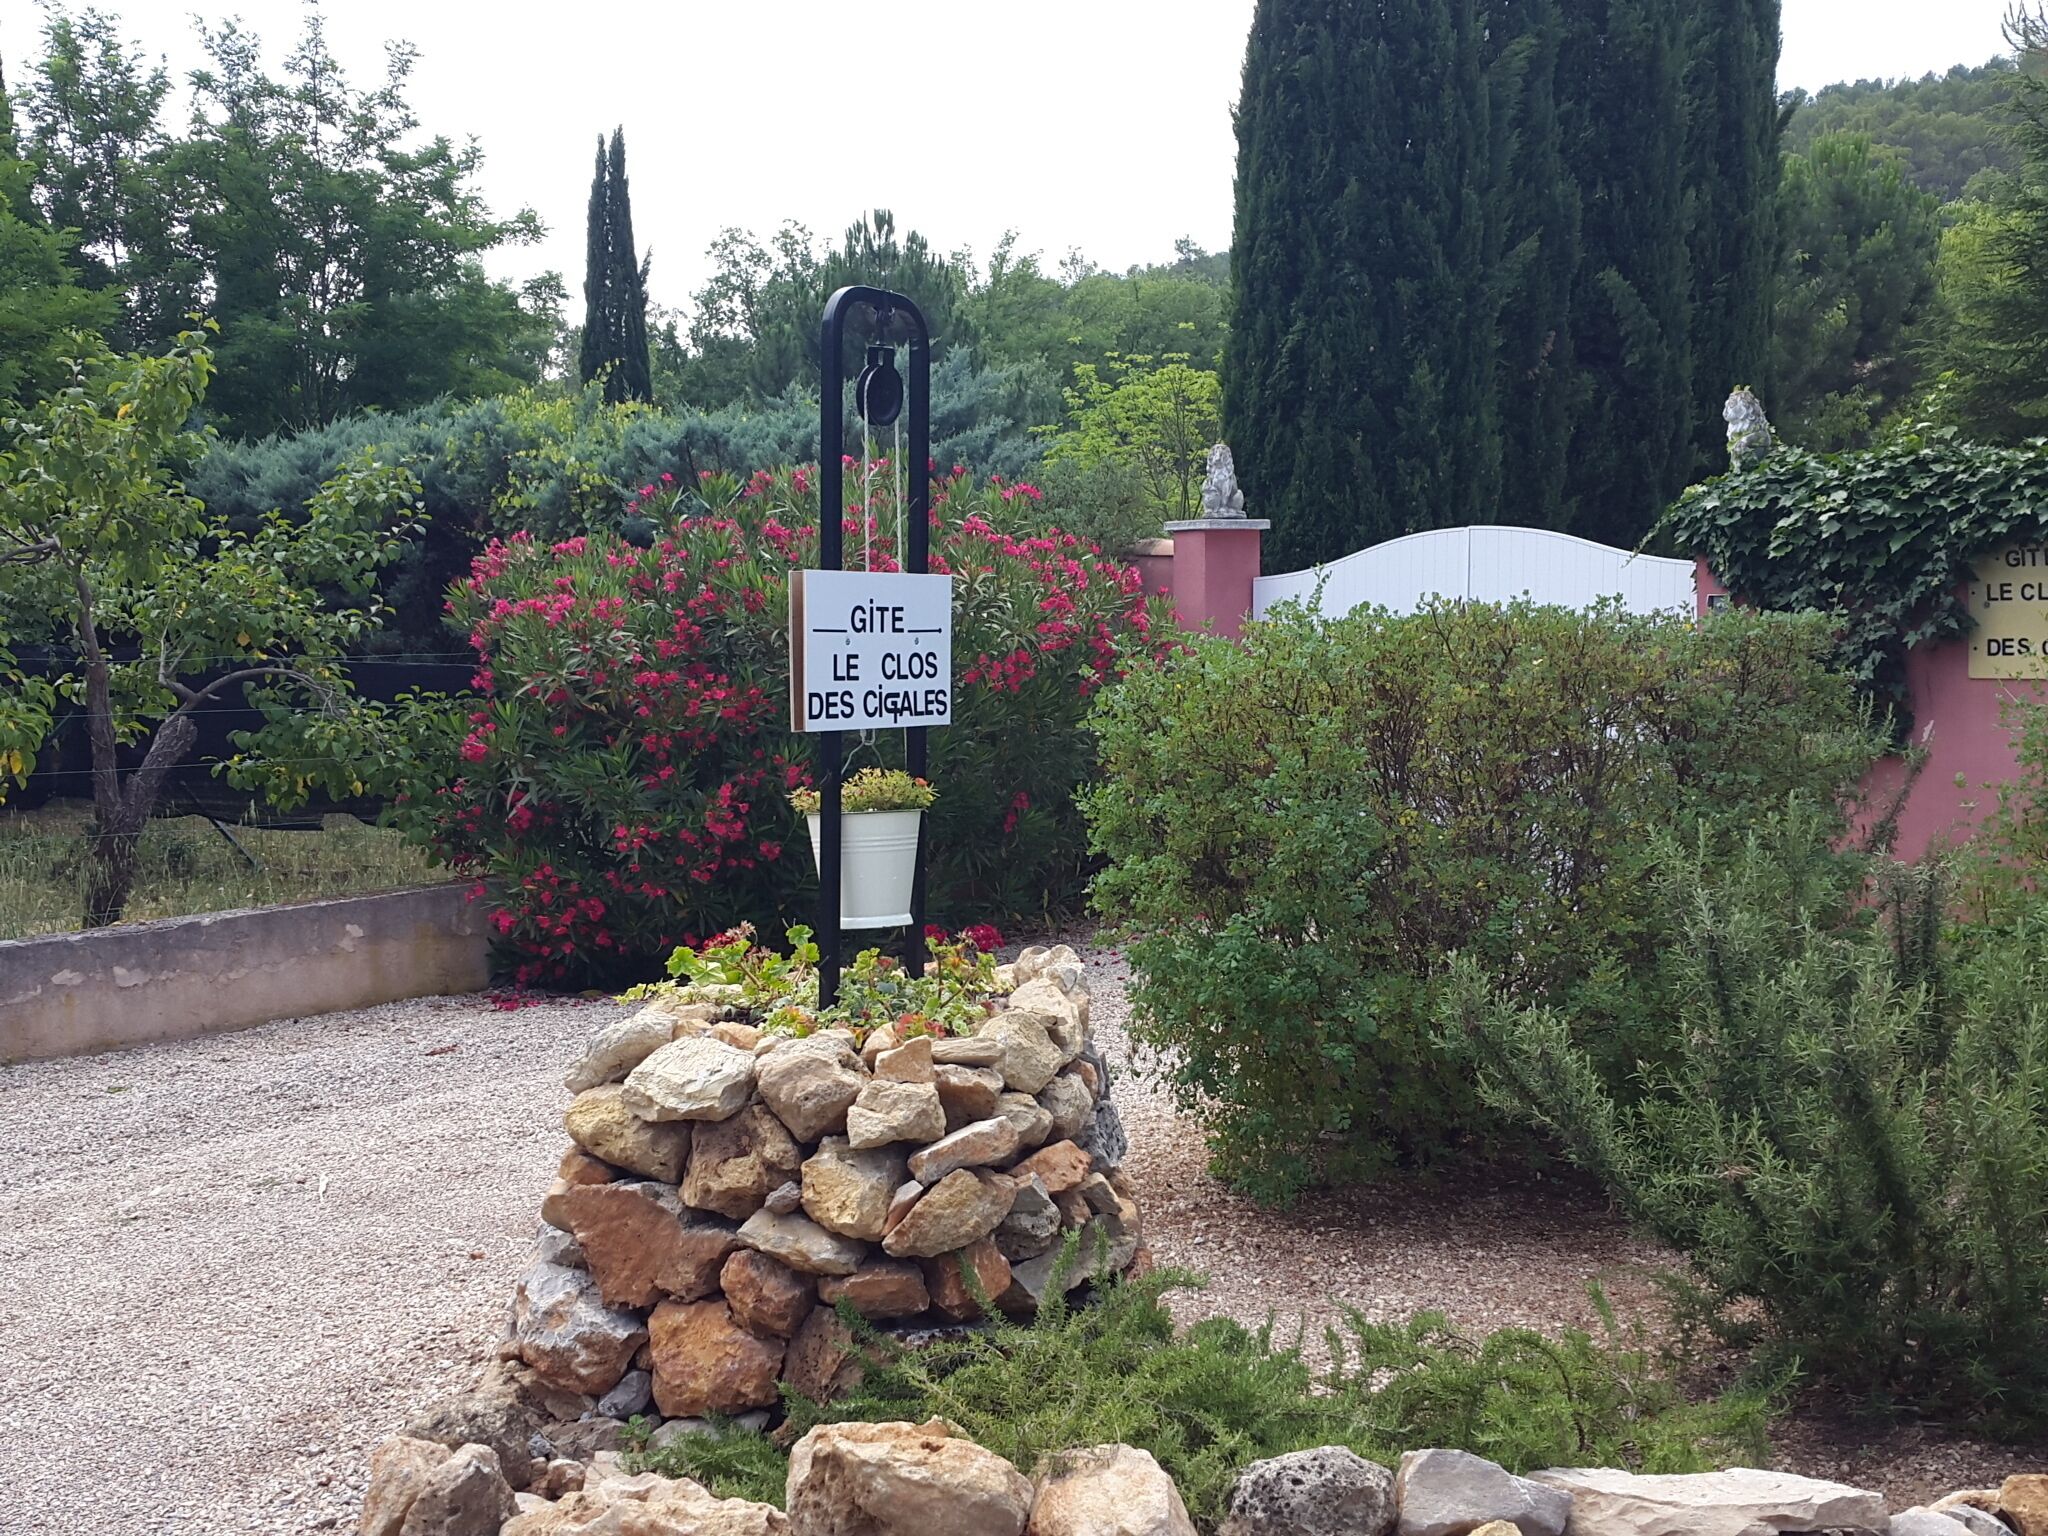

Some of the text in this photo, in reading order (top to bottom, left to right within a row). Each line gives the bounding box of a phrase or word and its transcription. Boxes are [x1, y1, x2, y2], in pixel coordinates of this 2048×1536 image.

[1986, 583, 2013, 601] LE
[1987, 638, 2030, 656] DES
[833, 652, 938, 681] LE CLOS
[808, 690, 854, 720] DES
